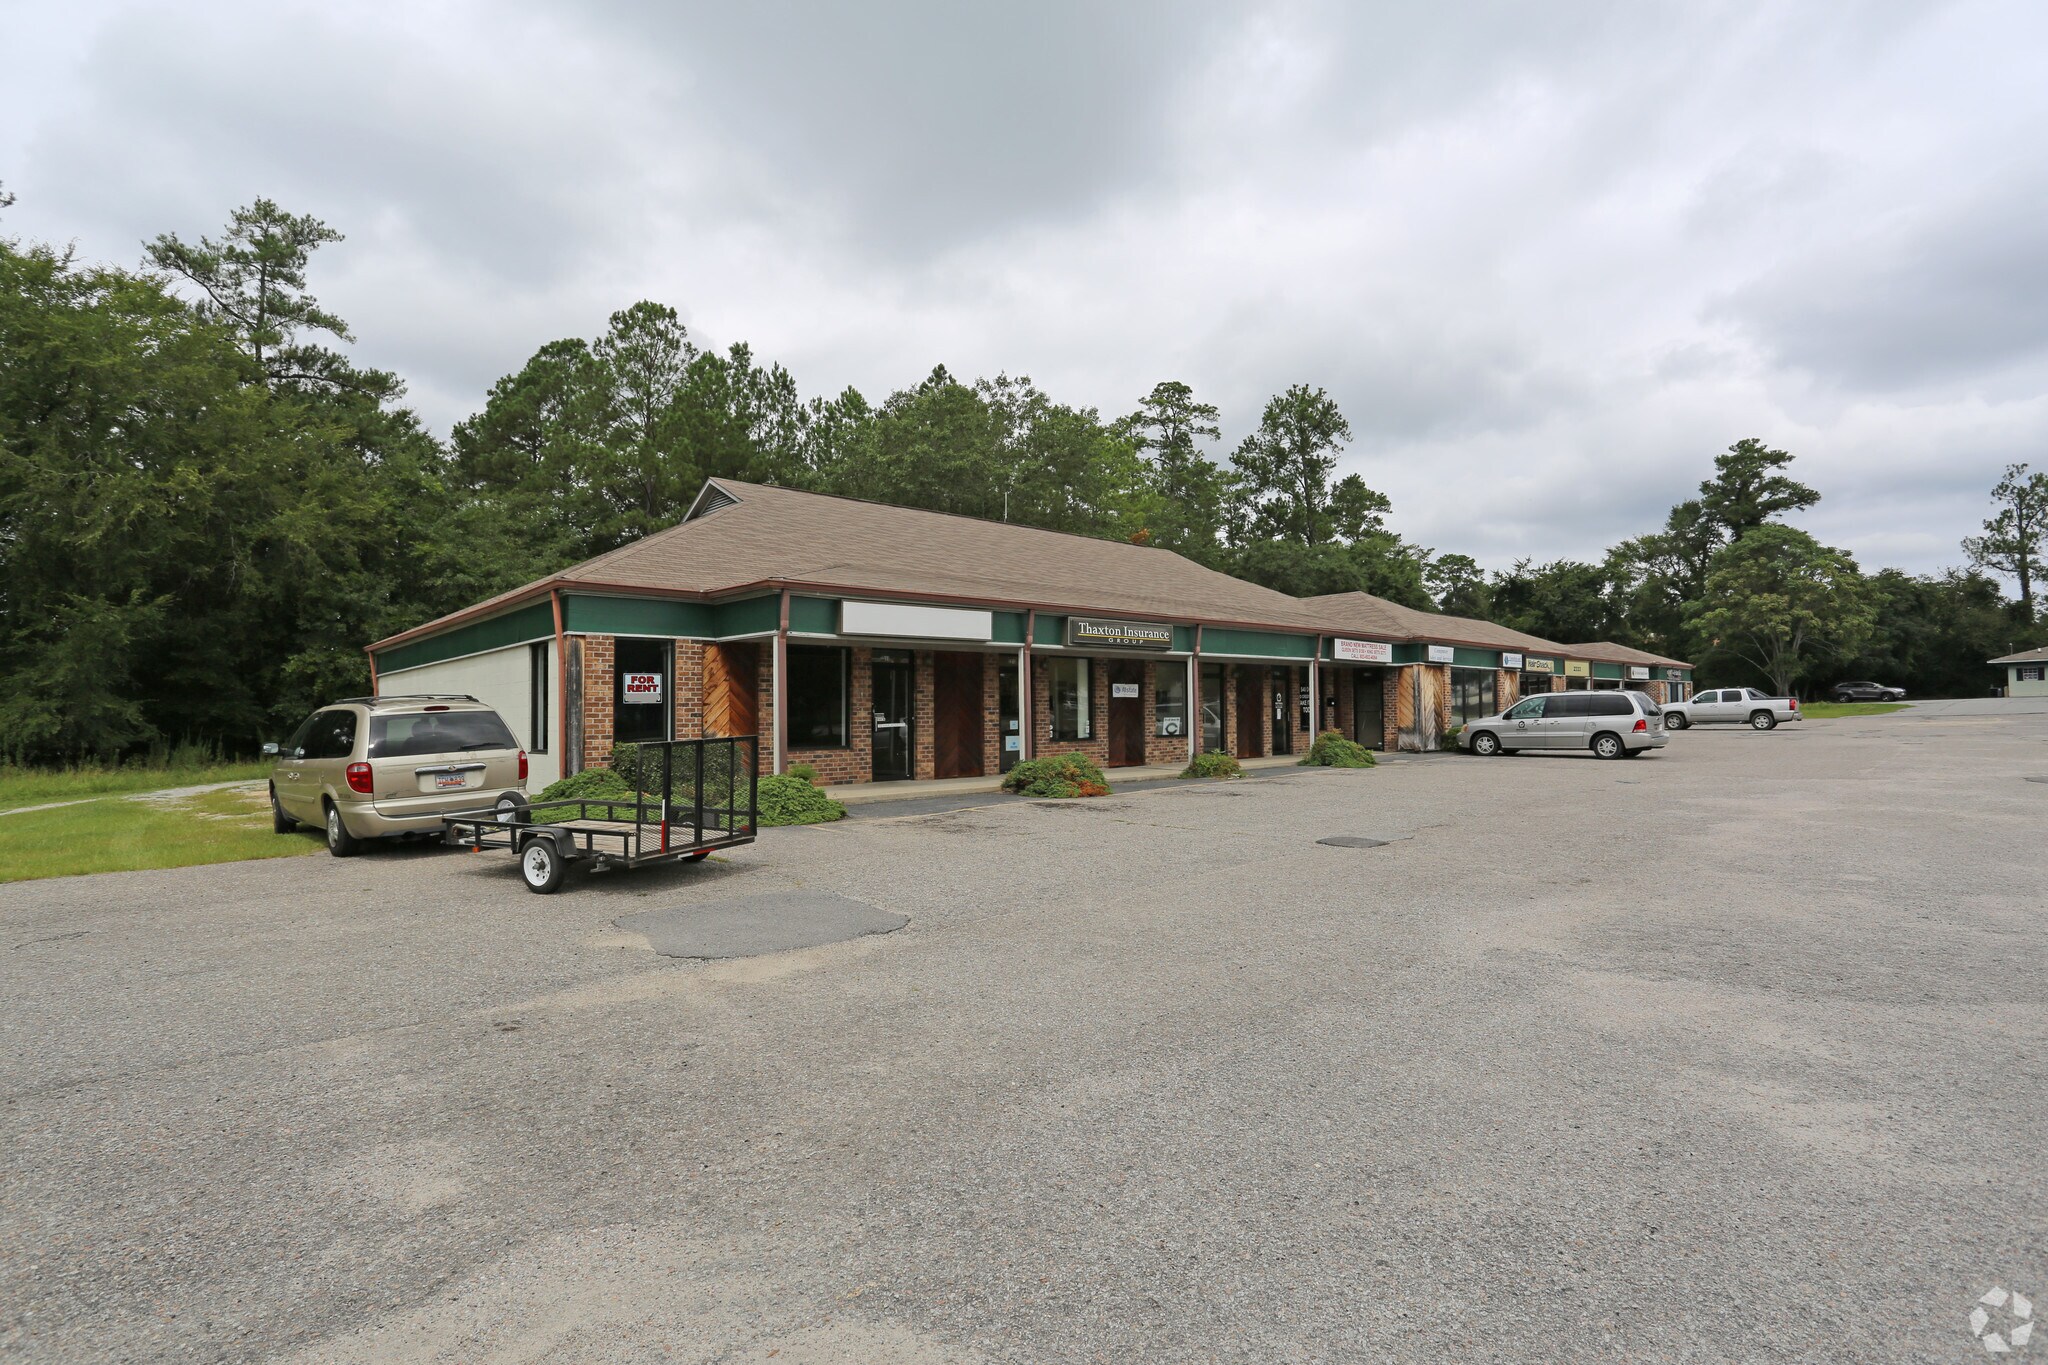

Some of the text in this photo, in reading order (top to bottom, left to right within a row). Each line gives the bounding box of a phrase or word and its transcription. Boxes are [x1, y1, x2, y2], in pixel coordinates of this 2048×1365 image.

[1078, 622, 1170, 639] Thaxton Insurance
[1108, 637, 1144, 645] GROUP
[627, 676, 658, 693] FOR RENT
